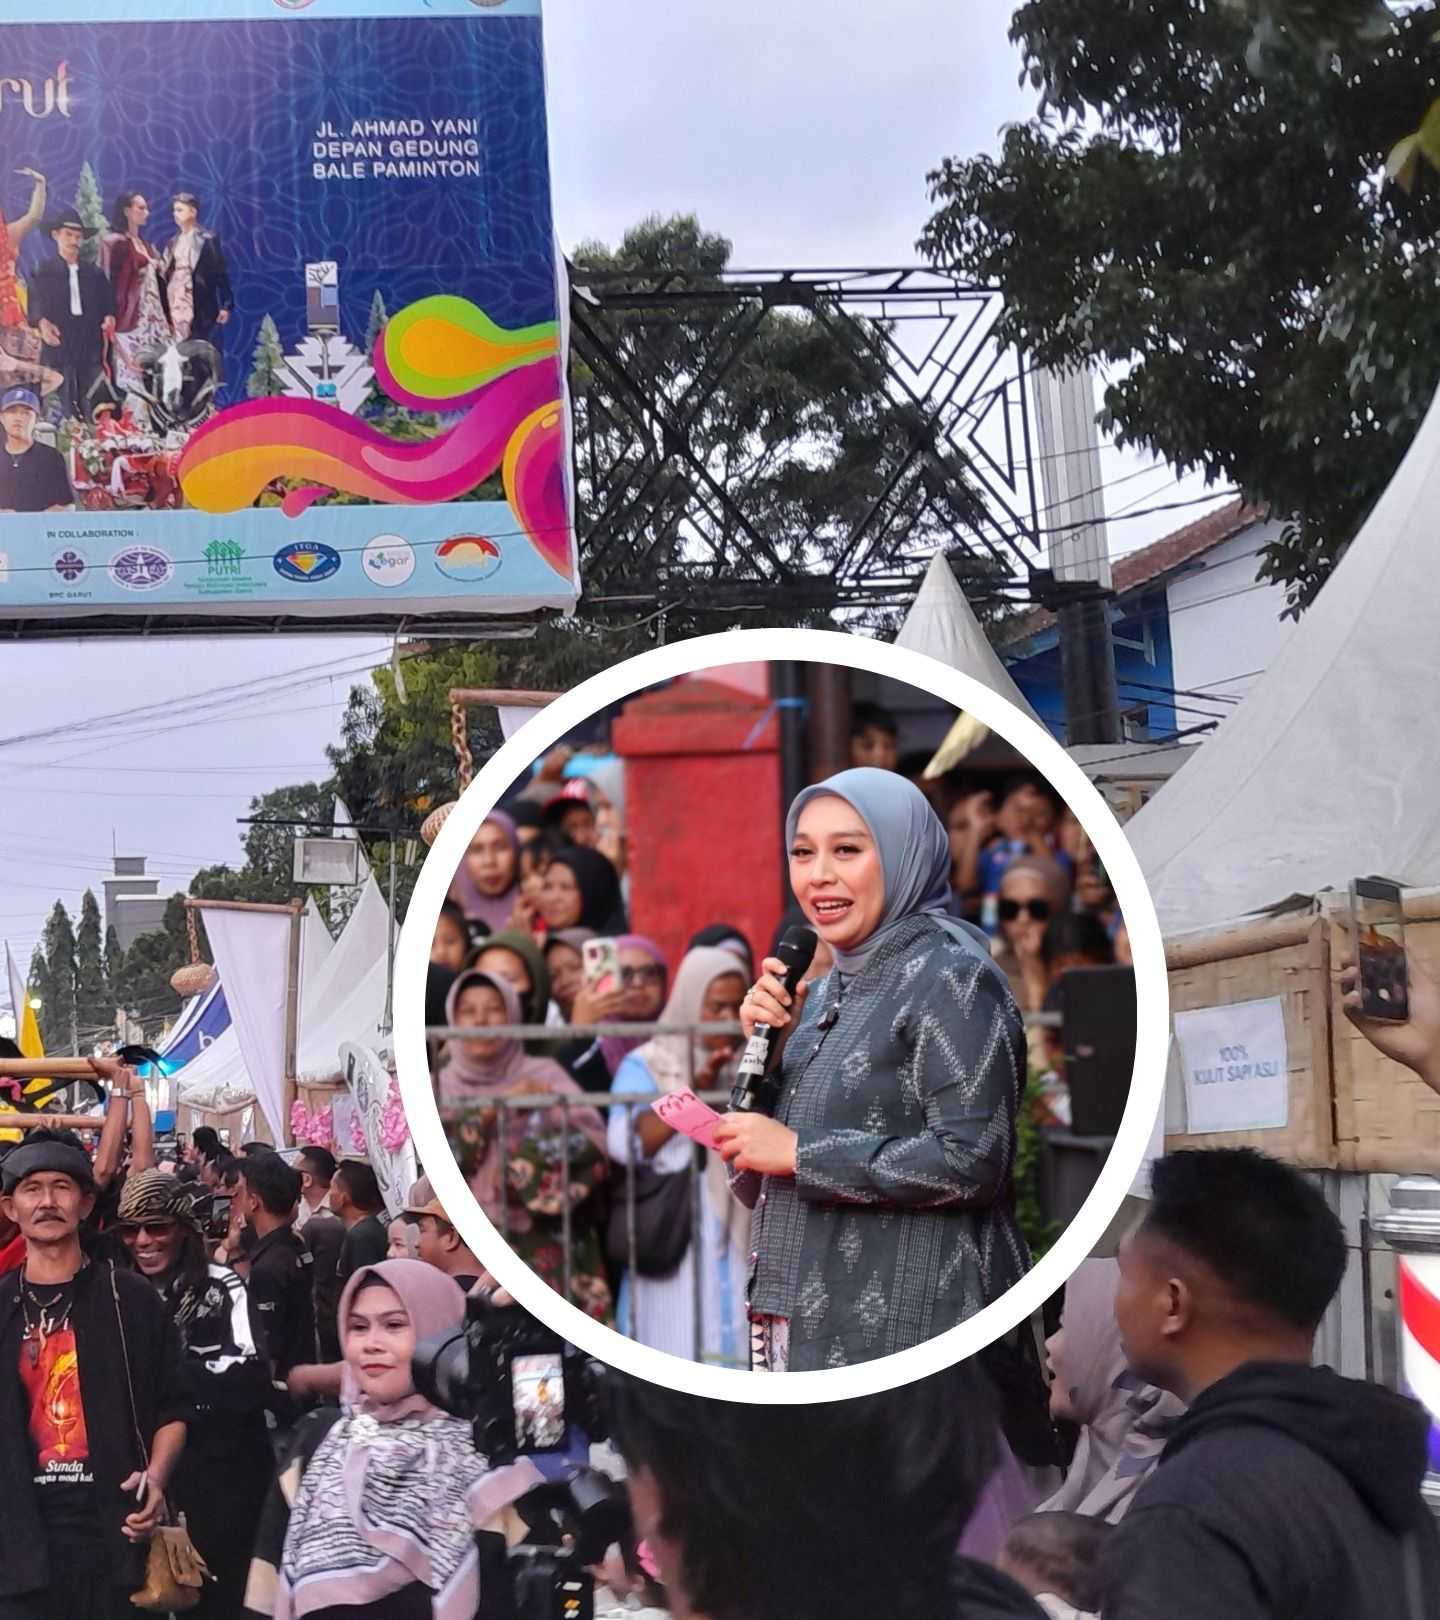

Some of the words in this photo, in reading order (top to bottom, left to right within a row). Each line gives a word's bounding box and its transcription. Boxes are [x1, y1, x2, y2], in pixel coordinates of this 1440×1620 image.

[316, 121, 344, 138] JL.
[351, 119, 425, 137] AHMAD
[431, 119, 479, 135] YANI
[313, 141, 382, 158] DEPAN
[389, 139, 479, 157] GEDUNG
[313, 162, 365, 179] BALE
[373, 160, 480, 178] PAMINTON
[47, 530, 56, 538] IN
[58, 529, 134, 538] COLLABORATION
[207, 564, 241, 576] PUTRI
[45, 1459, 84, 1473] Sunda
